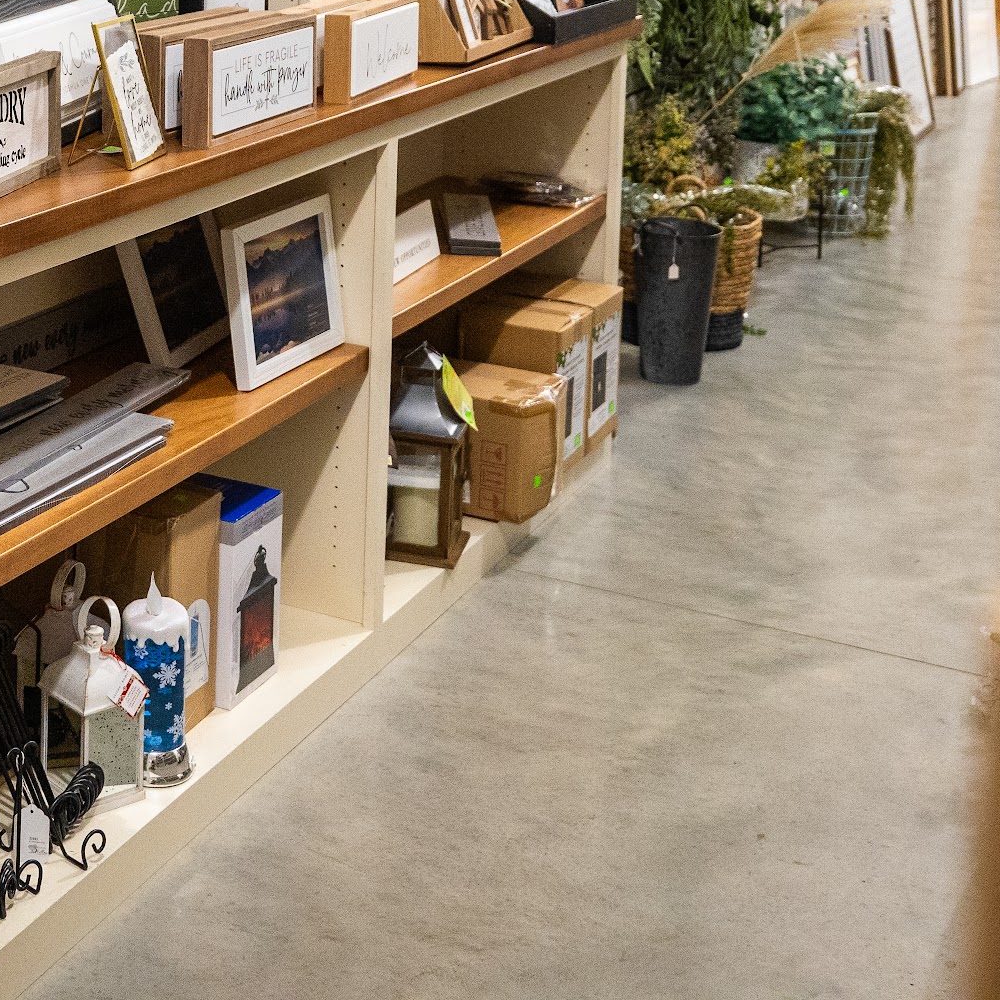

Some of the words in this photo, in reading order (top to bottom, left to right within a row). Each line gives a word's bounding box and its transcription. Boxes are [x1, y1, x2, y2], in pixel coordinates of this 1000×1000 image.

[235, 56, 252, 73] LIFE
[255, 53, 263, 68] IS
[266, 44, 298, 63] FRAGILE
[366, 24, 411, 79] Welcome
[257, 65, 276, 96] with
[278, 61, 308, 96] prayer
[12, 145, 26, 165] cycle
